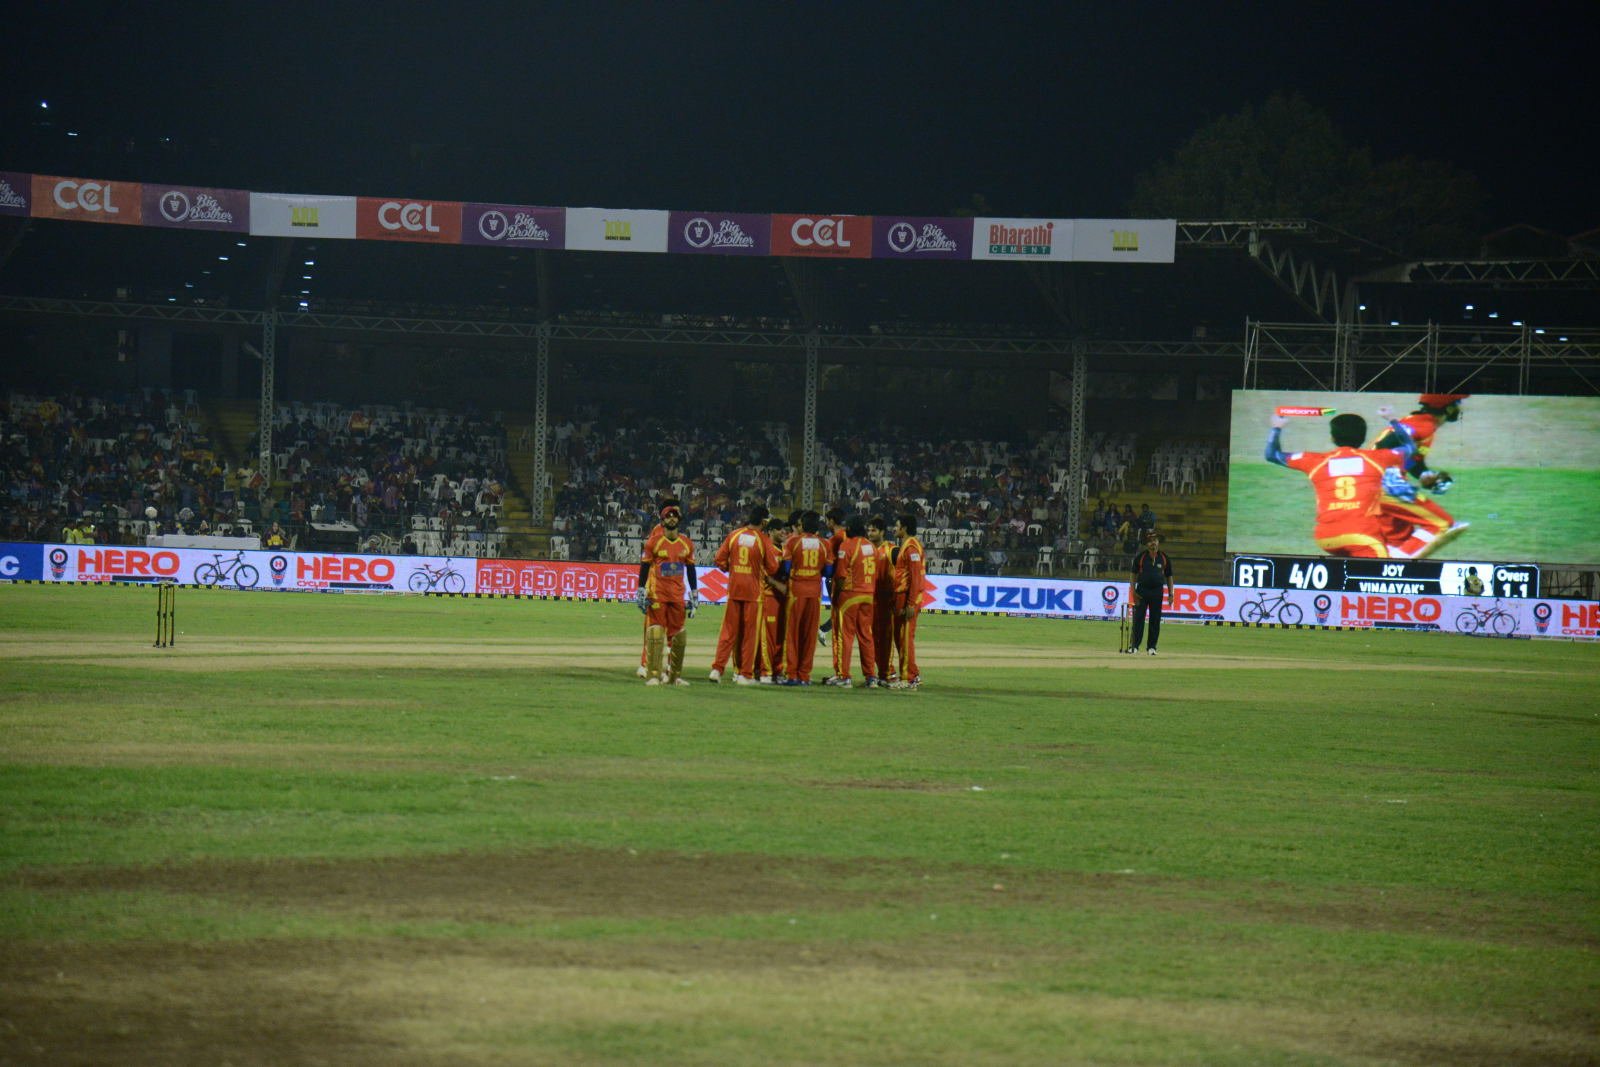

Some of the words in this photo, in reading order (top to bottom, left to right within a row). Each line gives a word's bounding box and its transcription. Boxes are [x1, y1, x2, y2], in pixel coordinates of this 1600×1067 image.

[53, 180, 119, 213] CCL
[197, 194, 219, 209] Big
[189, 206, 232, 221] Brother
[377, 201, 440, 233] CCL
[514, 212, 536, 228] Big
[507, 225, 550, 239] Brother
[719, 220, 741, 234] Big
[791, 218, 850, 247] CCL
[922, 223, 944, 239] Big
[990, 222, 1053, 249] Bharathi
[713, 231, 754, 246] Brother
[916, 236, 957, 249] Brother
[992, 246, 1047, 254] CEMENT
[77, 549, 180, 575] HERO
[739, 546, 749, 565] 9
[802, 549, 819, 567] 18
[296, 556, 395, 582] HERO
[862, 556, 876, 575] 15
[1382, 564, 1406, 577] JOY
[77, 574, 111, 582] CYCLES
[297, 580, 329, 588] CYCLES
[479, 568, 516, 589] RED
[520, 569, 557, 591] RED
[562, 571, 599, 592] RED
[603, 573, 640, 593] RED
[1239, 563, 1269, 588] BT
[1289, 563, 1329, 590] 4/0
[1497, 569, 1530, 582] Overs
[945, 584, 1083, 611] SUZUKI
[1140, 587, 1226, 613] RO
[1502, 583, 1528, 598] 1.1
[1341, 595, 1442, 622] HERO
[1341, 619, 1374, 627] CYCLES
